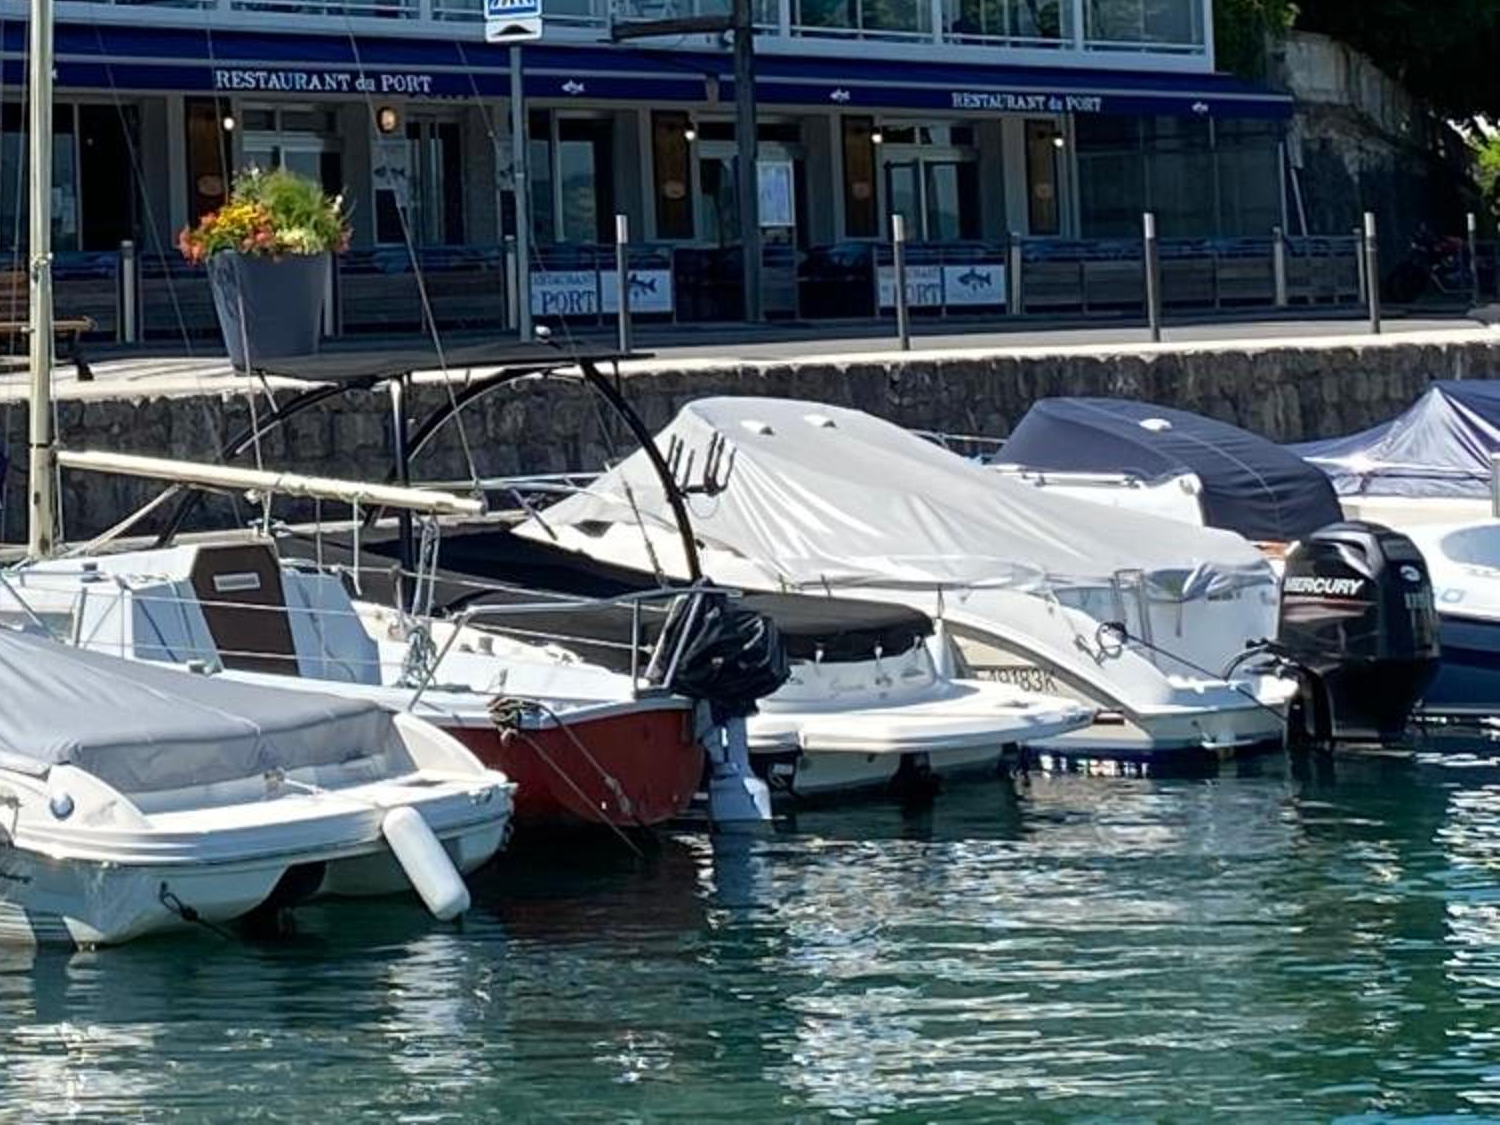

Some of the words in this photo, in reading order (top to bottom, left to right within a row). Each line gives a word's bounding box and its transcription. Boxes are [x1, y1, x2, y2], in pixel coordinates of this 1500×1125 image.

[215, 70, 350, 90] RESTAURANT
[355, 76, 376, 91] du
[381, 74, 432, 92] PORT
[952, 92, 1047, 109] RESTAURANT
[1066, 96, 1102, 112] PORT
[541, 290, 595, 315] PORT
[1283, 577, 1364, 595] MERCURY
